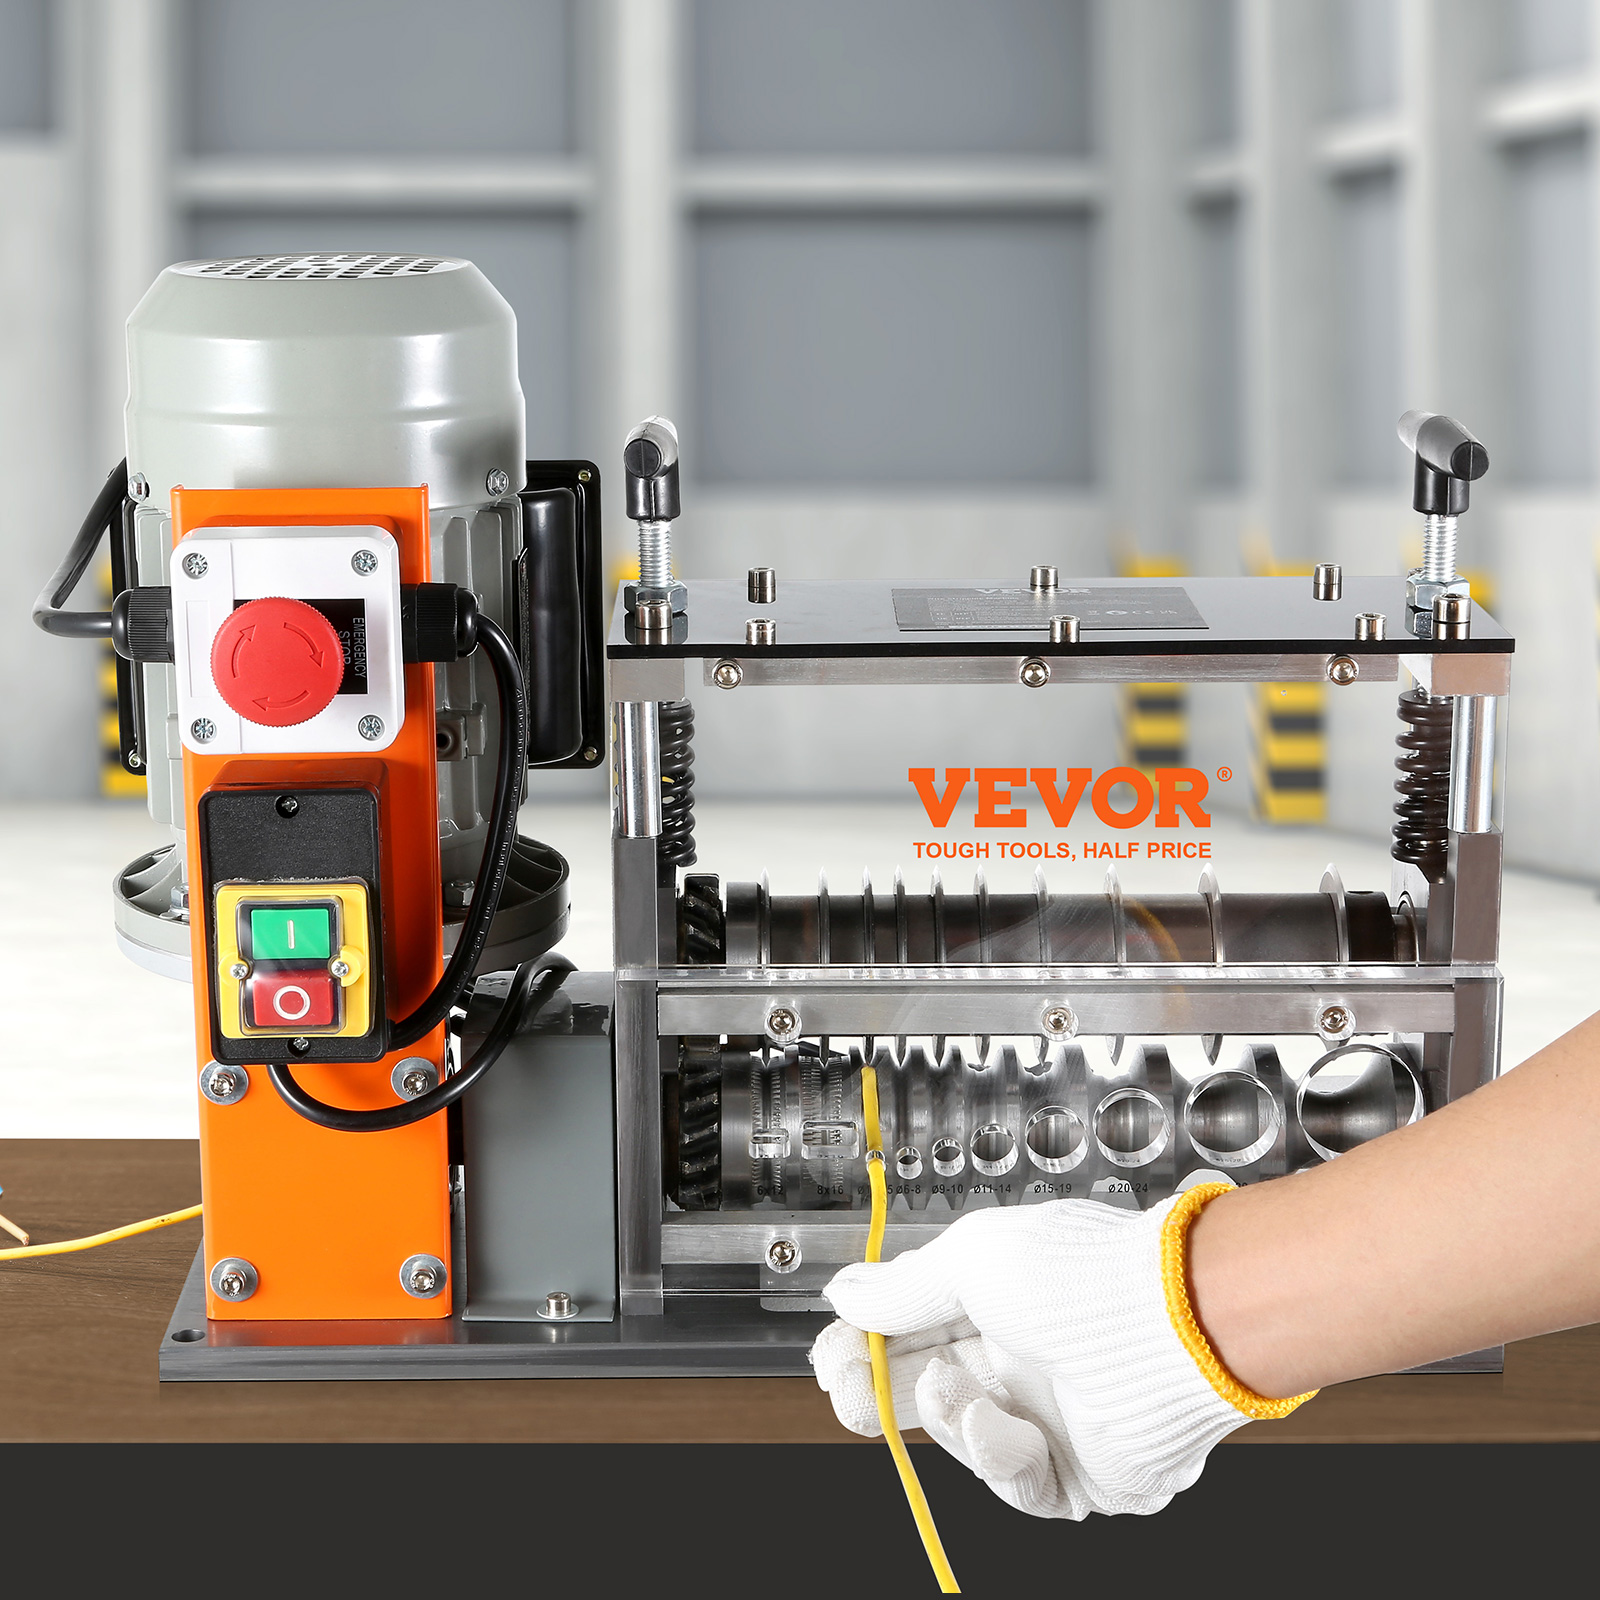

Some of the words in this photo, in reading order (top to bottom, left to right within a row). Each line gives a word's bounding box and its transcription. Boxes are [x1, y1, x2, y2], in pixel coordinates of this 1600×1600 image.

[352, 617, 367, 679] EMERGENCY
[912, 842, 990, 859] TOUGH
[996, 842, 1077, 862] TOOLS,
[1083, 842, 1140, 859] HALF
[1147, 842, 1212, 859] PRICE
[757, 1185, 784, 1195] 6x12
[817, 1185, 844, 1195] 8x16
